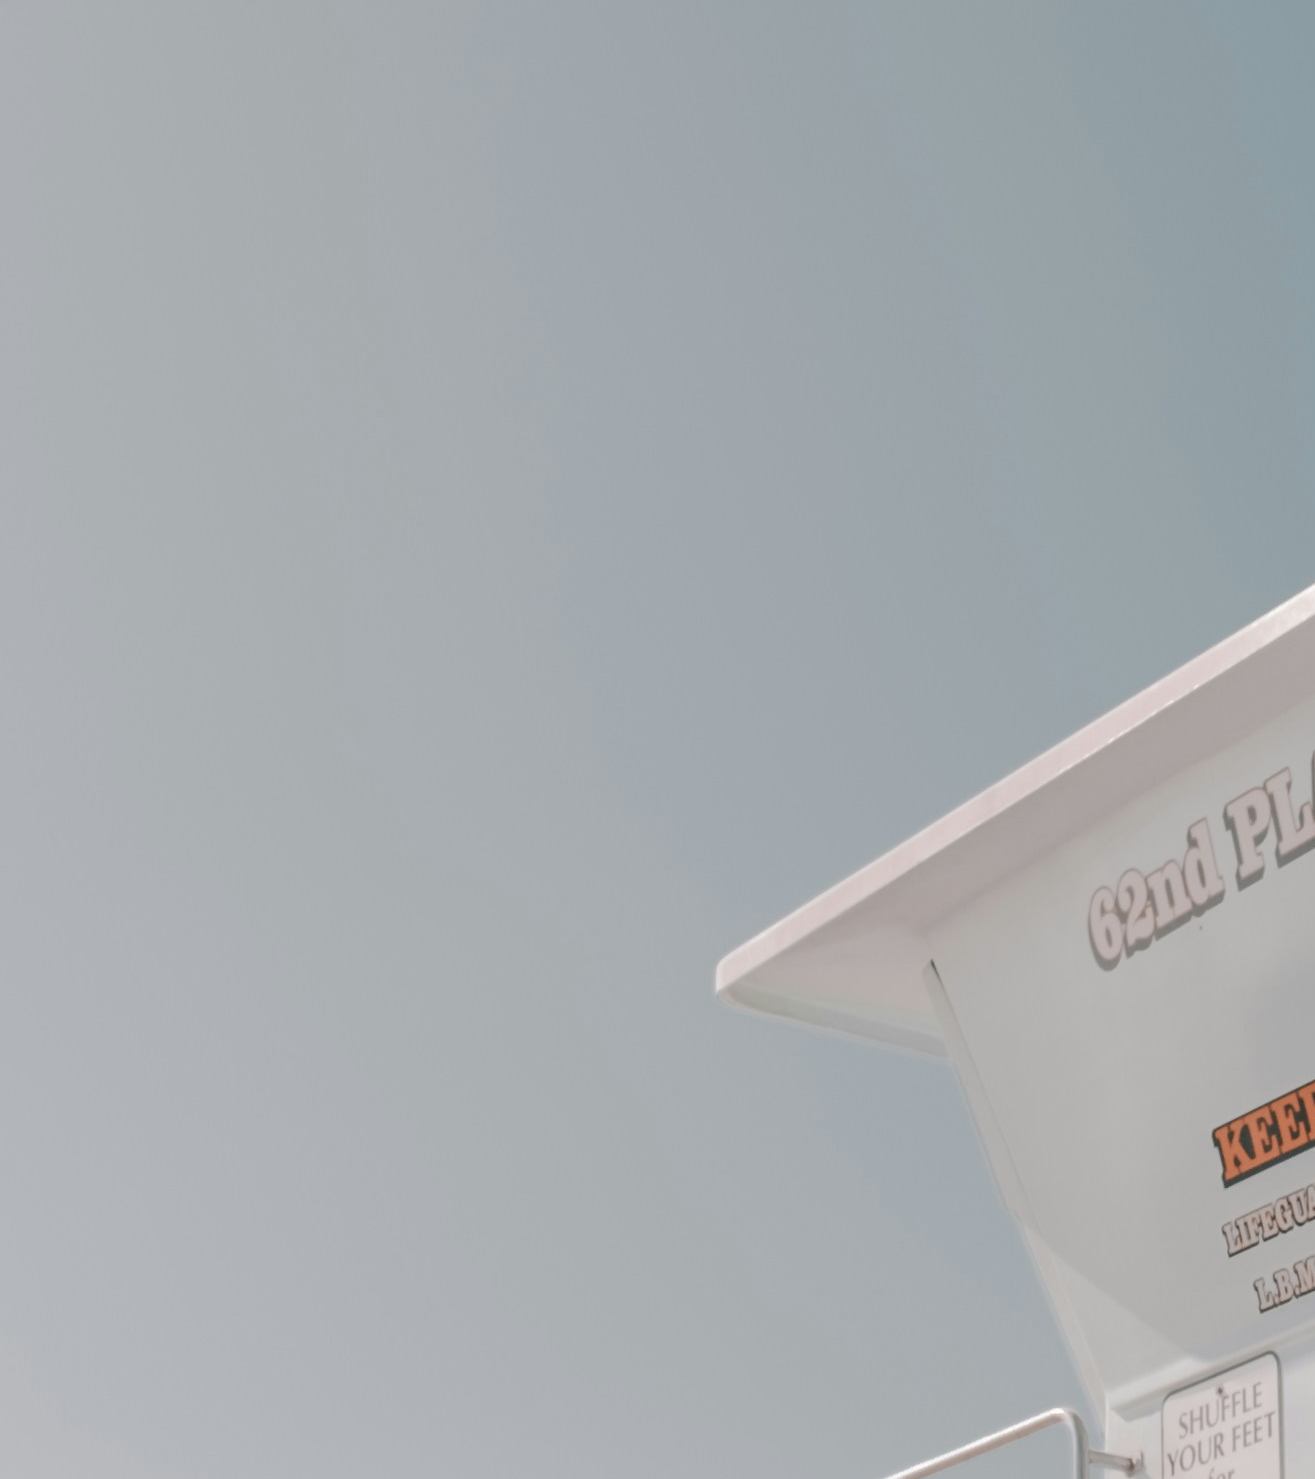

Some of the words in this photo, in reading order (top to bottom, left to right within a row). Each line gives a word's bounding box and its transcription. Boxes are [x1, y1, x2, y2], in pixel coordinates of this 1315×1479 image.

[1088, 817, 1225, 971] 62nd
[1167, 1432, 1225, 1477] YOUR
[1232, 1410, 1276, 1453] FEET
[1178, 1381, 1262, 1440] SHUFFLE
